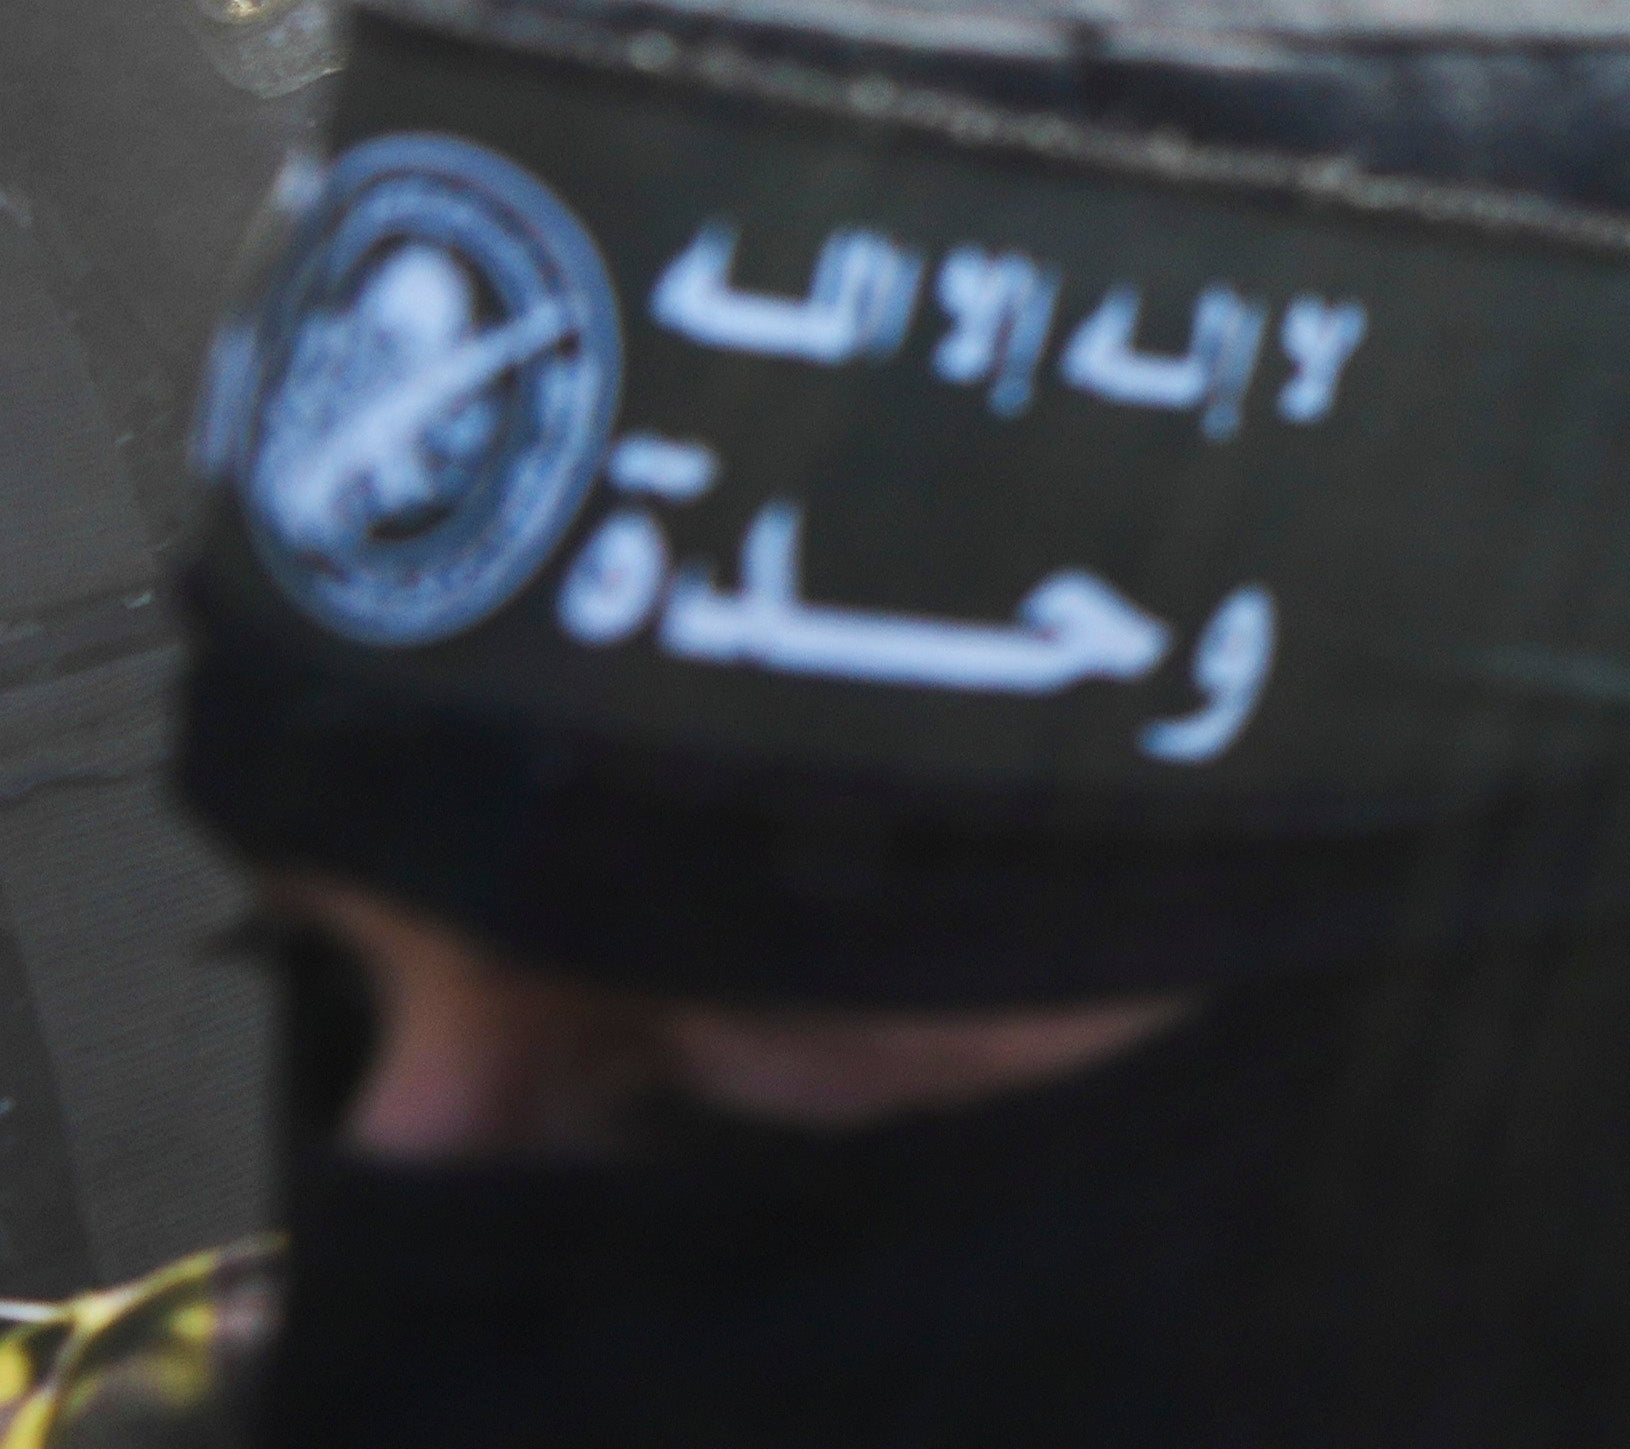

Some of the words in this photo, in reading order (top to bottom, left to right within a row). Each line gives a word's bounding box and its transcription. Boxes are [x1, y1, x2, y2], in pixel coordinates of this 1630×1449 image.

[648, 218, 927, 368] الله
[1278, 290, 1368, 425] لا
[558, 430, 1274, 760] وحدة
